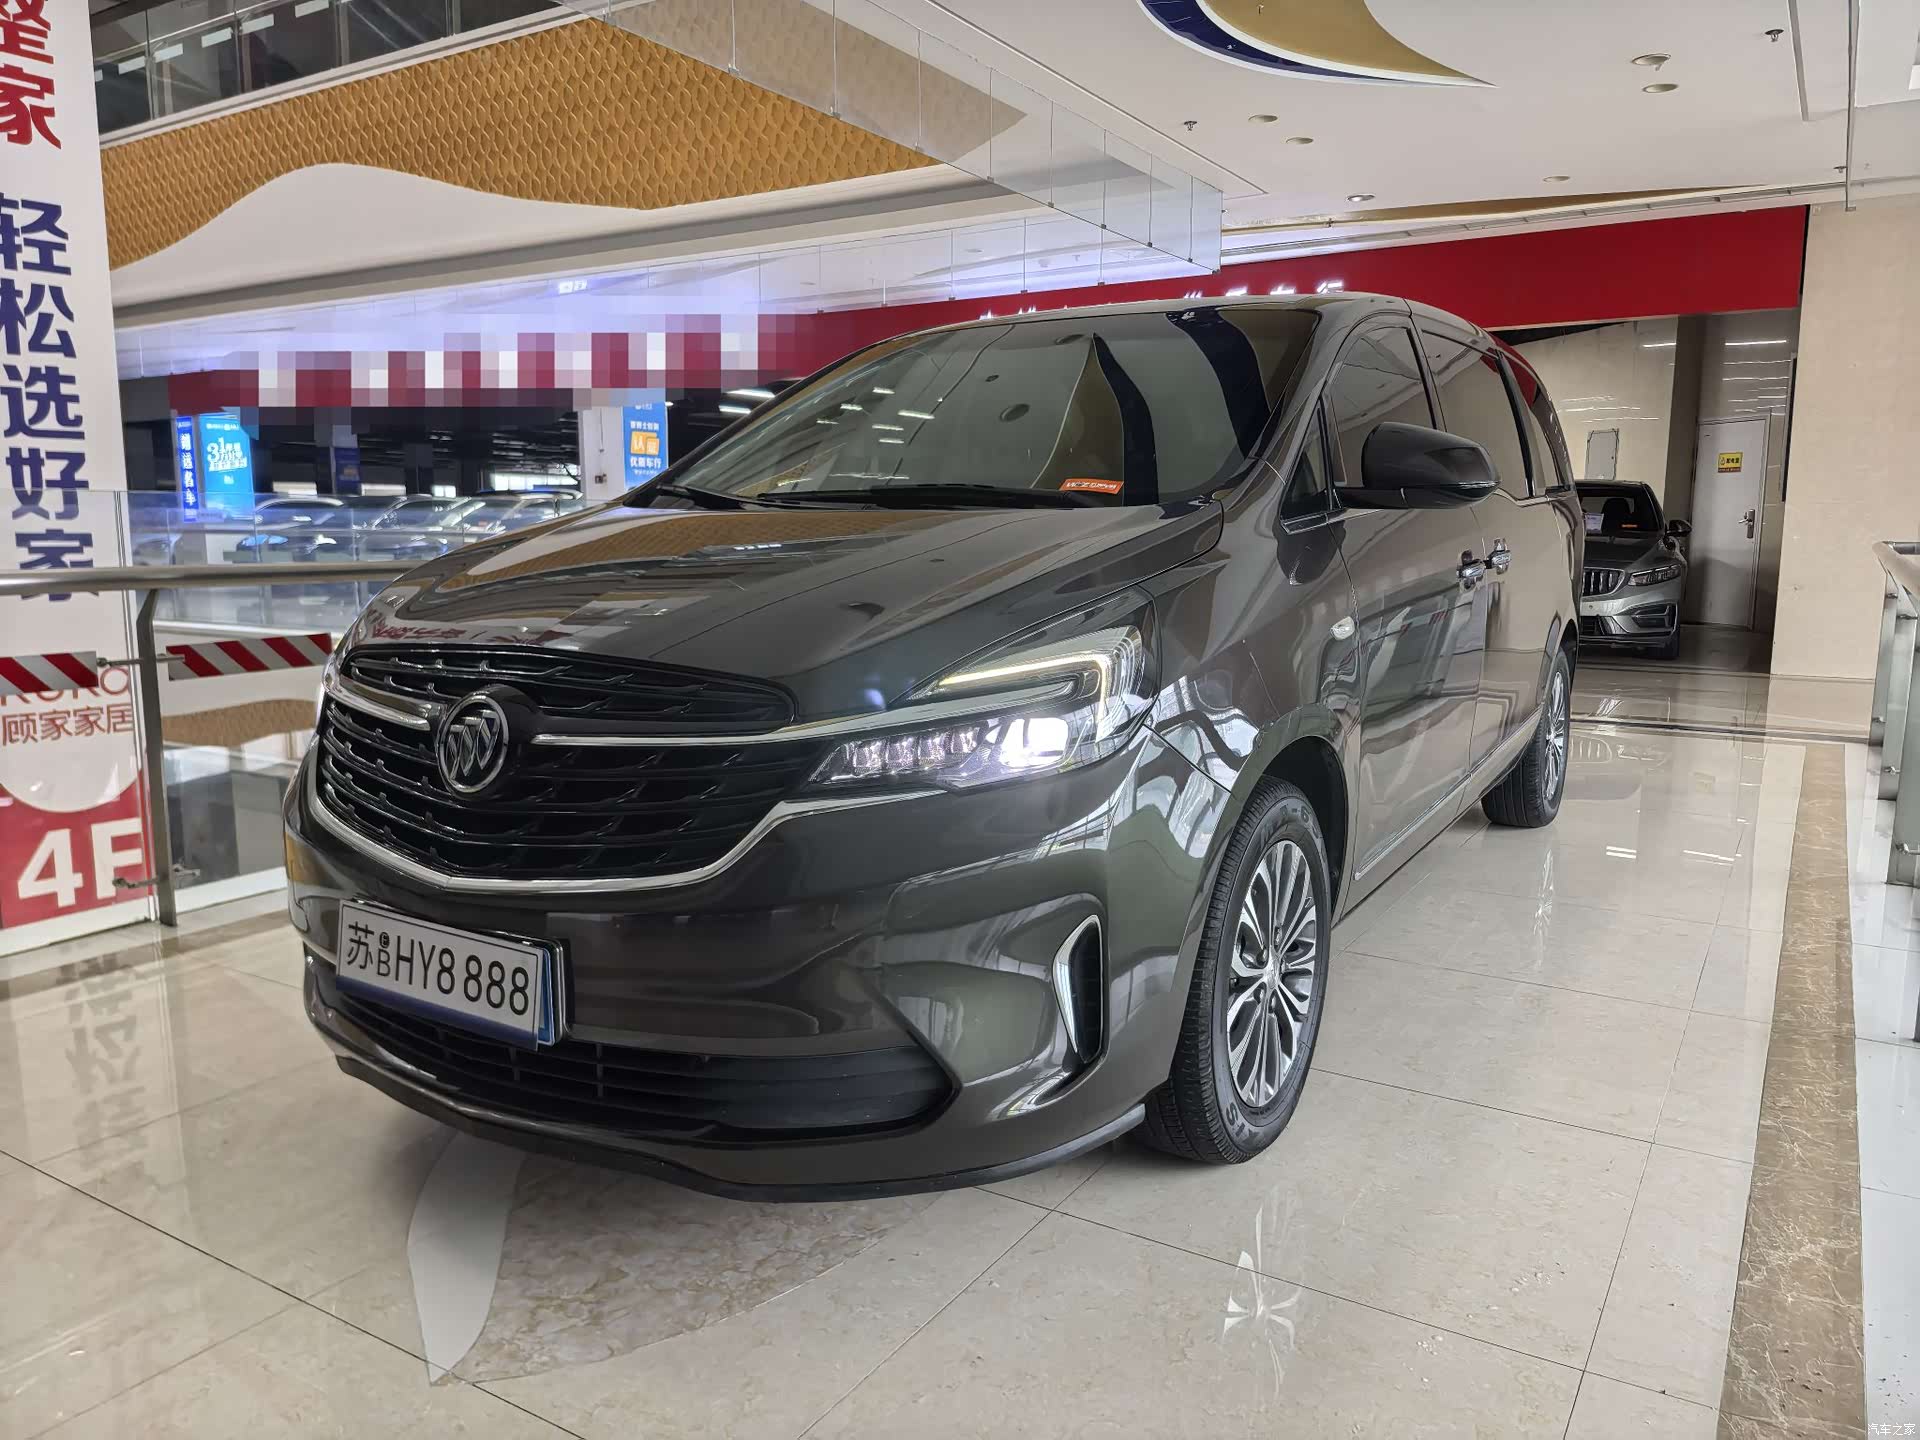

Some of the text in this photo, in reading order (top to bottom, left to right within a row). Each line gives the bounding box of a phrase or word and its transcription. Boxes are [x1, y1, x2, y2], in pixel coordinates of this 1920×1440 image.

[0, 193, 99, 601] 轻松选好家
[2, 703, 134, 746] 顾家家居
[18, 817, 142, 908] 4F
